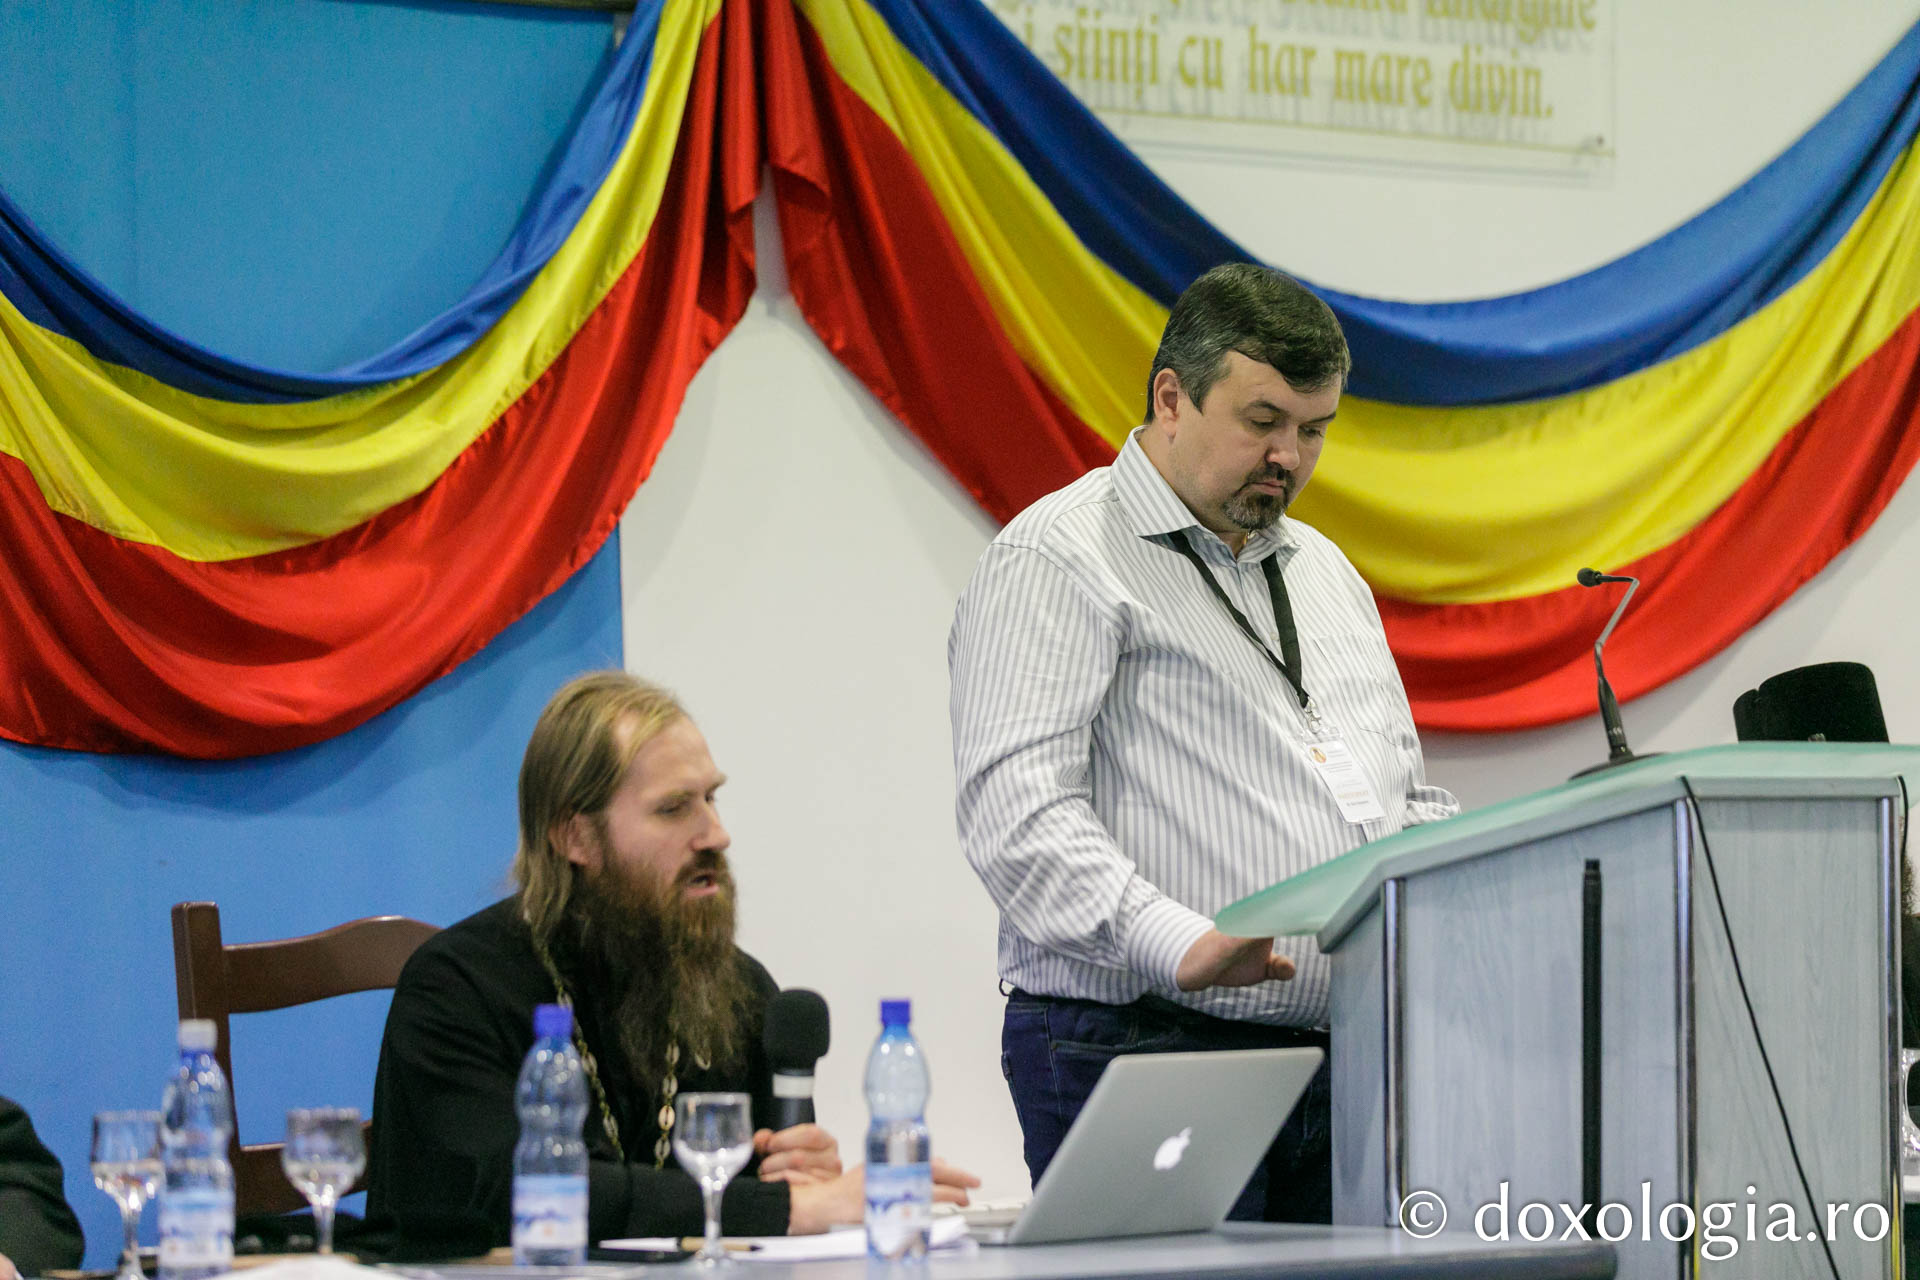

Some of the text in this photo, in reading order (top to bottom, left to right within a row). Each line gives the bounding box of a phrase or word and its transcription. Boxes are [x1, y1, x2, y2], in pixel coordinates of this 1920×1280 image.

[1178, 34, 1224, 91] cu
[1249, 22, 1317, 98] har
[1333, 48, 1431, 108] mare
[1450, 43, 1553, 118] divin.
